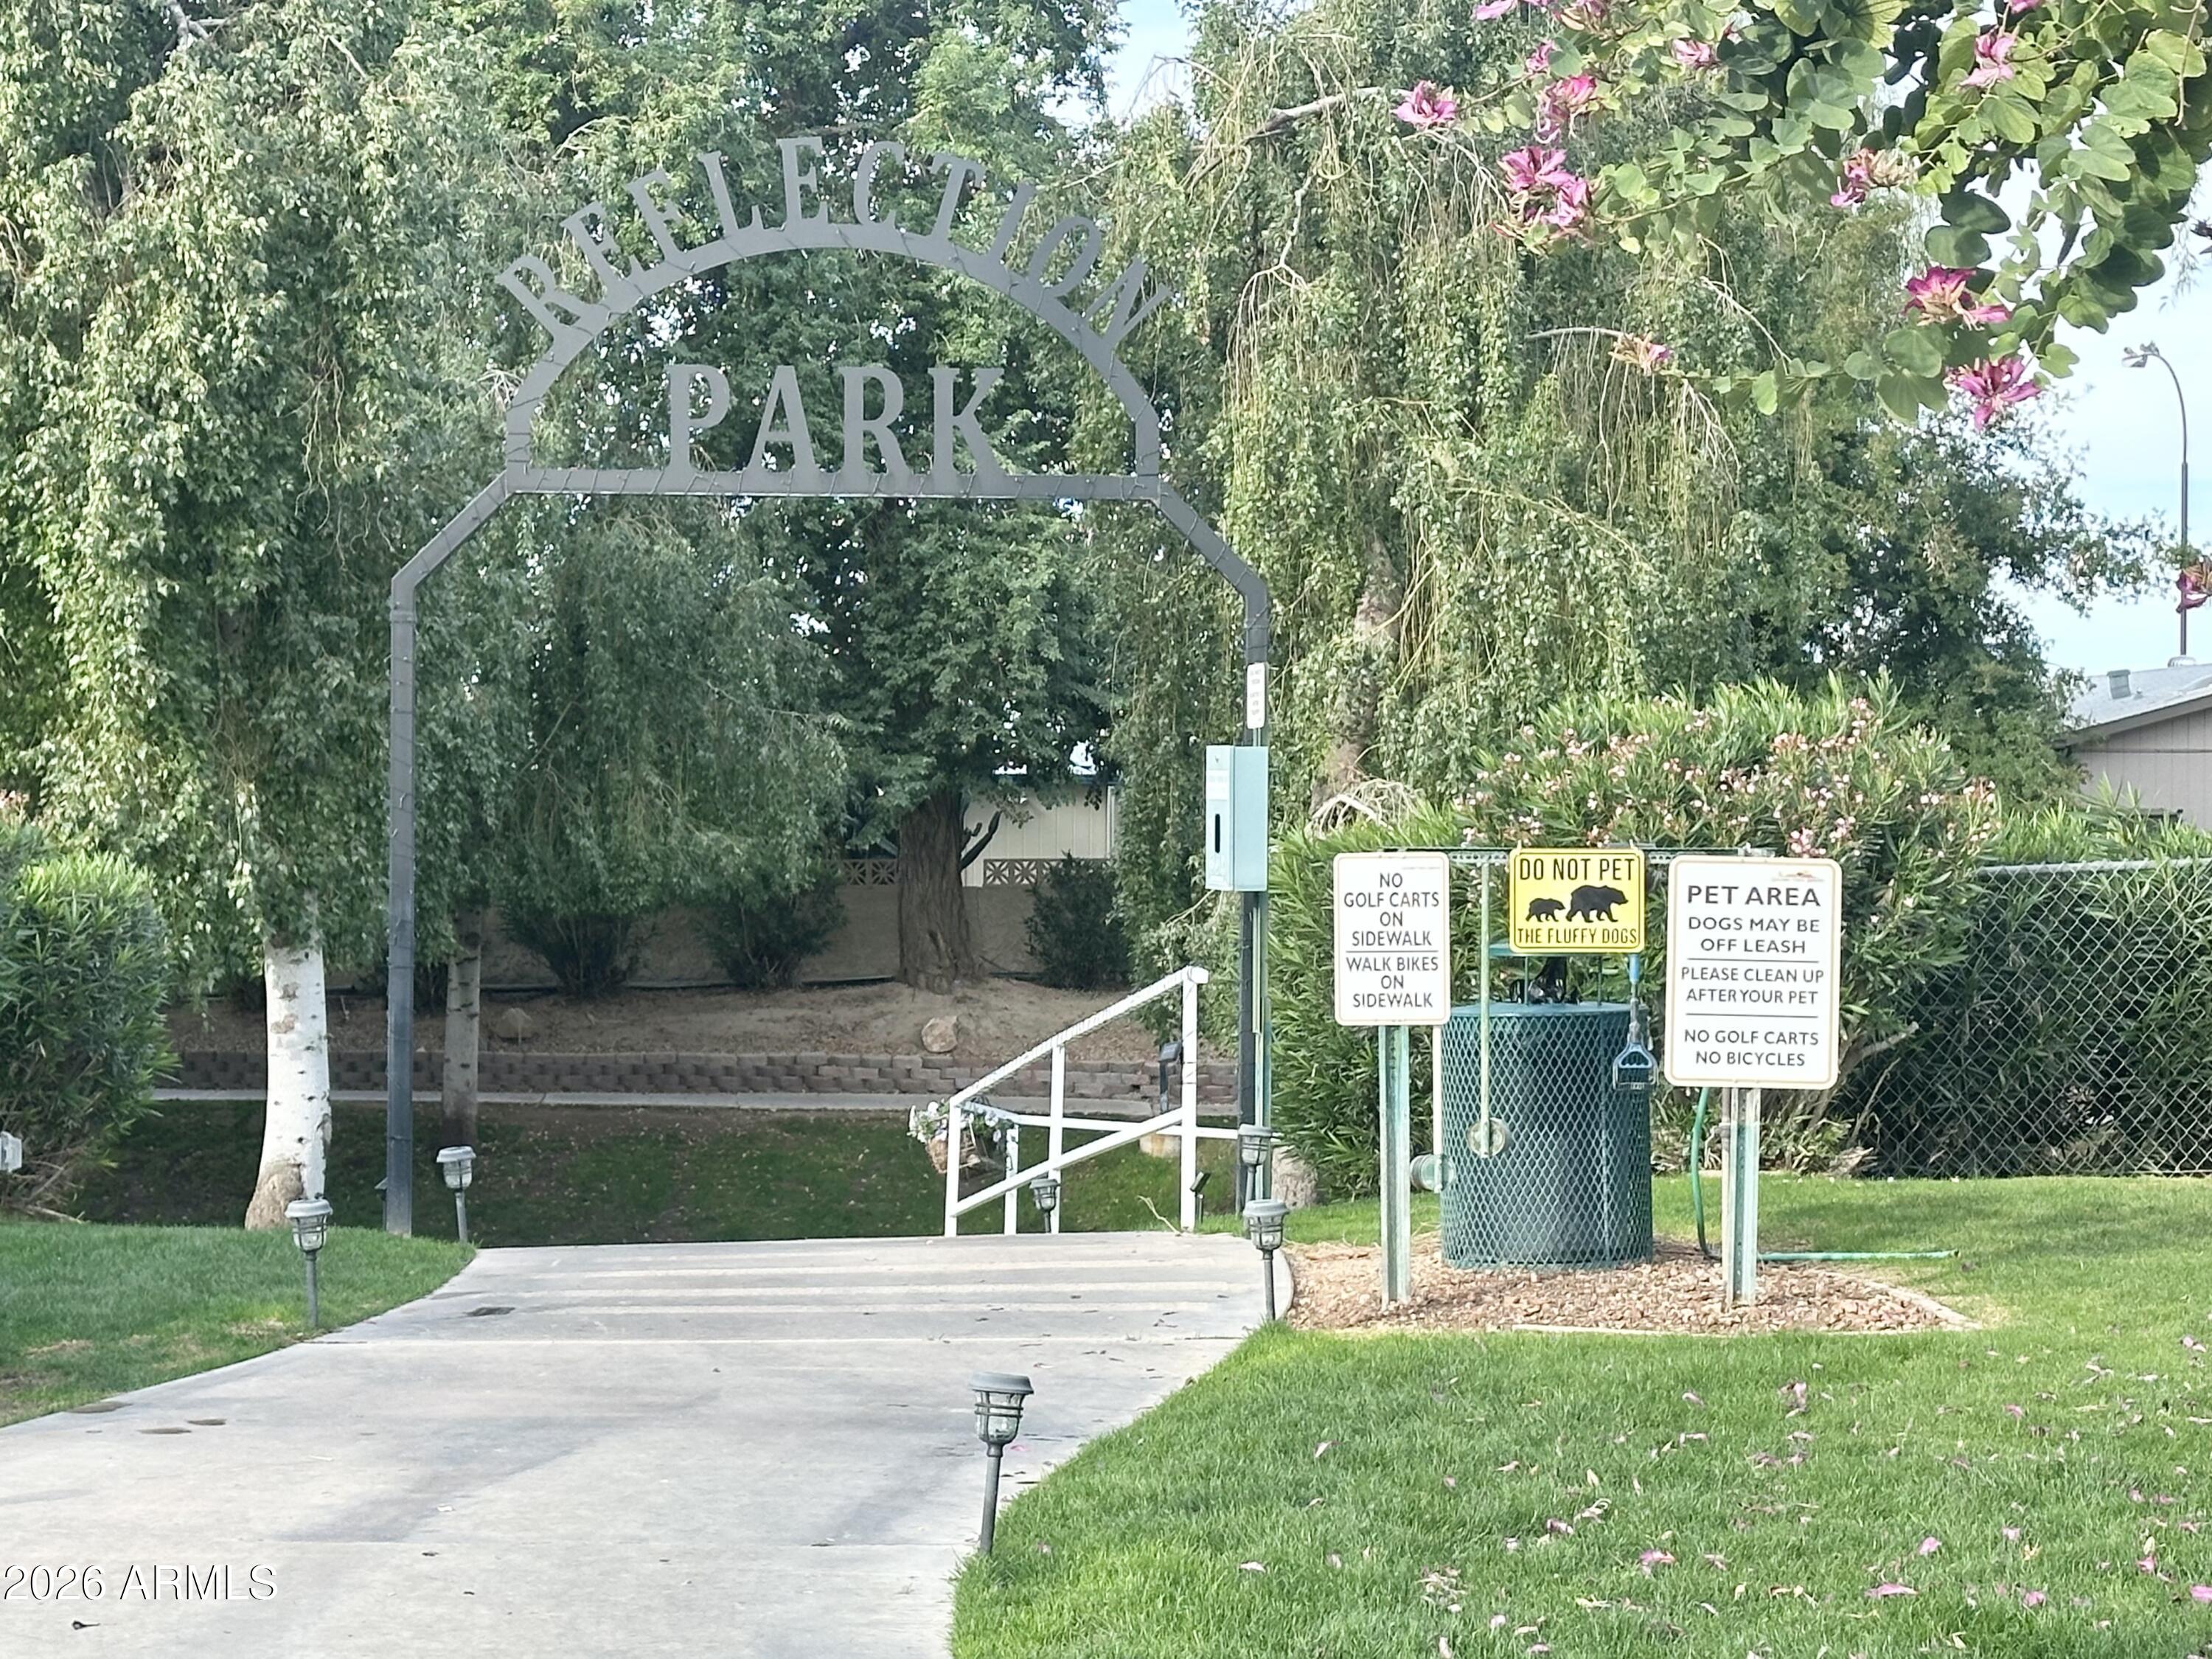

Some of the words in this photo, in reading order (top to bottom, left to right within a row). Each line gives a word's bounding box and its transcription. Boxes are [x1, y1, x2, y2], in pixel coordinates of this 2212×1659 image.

[497, 136, 1173, 349] REFLECTION
[666, 364, 1009, 476] PARK
[1520, 858, 1544, 880] DO
[1554, 858, 1590, 880] NOT
[1599, 858, 1635, 880] PET
[1380, 872, 1403, 888] NO
[1344, 892, 1385, 908] GOLF
[1389, 891, 1439, 908] CARTS
[1688, 885, 1739, 905] PET
[1745, 886, 1821, 907] AREA
[1380, 911, 1403, 927] ON
[1688, 917, 1743, 931] DOGS
[1750, 918, 1790, 932] MAY
[1797, 919, 1820, 933] BE
[1352, 931, 1433, 947] SIDEWALK
[1517, 928, 1543, 944] THE
[1548, 928, 1597, 944] FLUFFY
[1602, 928, 1637, 944] DOGS
[1700, 938, 1737, 951] OFF
[1744, 939, 1806, 954] LEASH
[1346, 957, 1391, 972] WALK
[1397, 956, 1439, 972] BIKES
[1380, 975, 1404, 990] ON
[1681, 967, 1739, 981] PLEASE
[1744, 968, 1797, 982] CLEAN
[1803, 970, 1824, 983] UP
[1352, 992, 1433, 1008] SIDEWALK
[1686, 988, 1736, 1002] AFTER
[1739, 990, 1784, 1004] YOUR
[1788, 990, 1818, 1004] PET
[1684, 1029, 1710, 1043] NO
[1714, 1029, 1759, 1044] GOLF
[1764, 1031, 1819, 1046] CARTS
[1696, 1051, 1721, 1065] NO
[1727, 1051, 1805, 1067] BICYCLES
